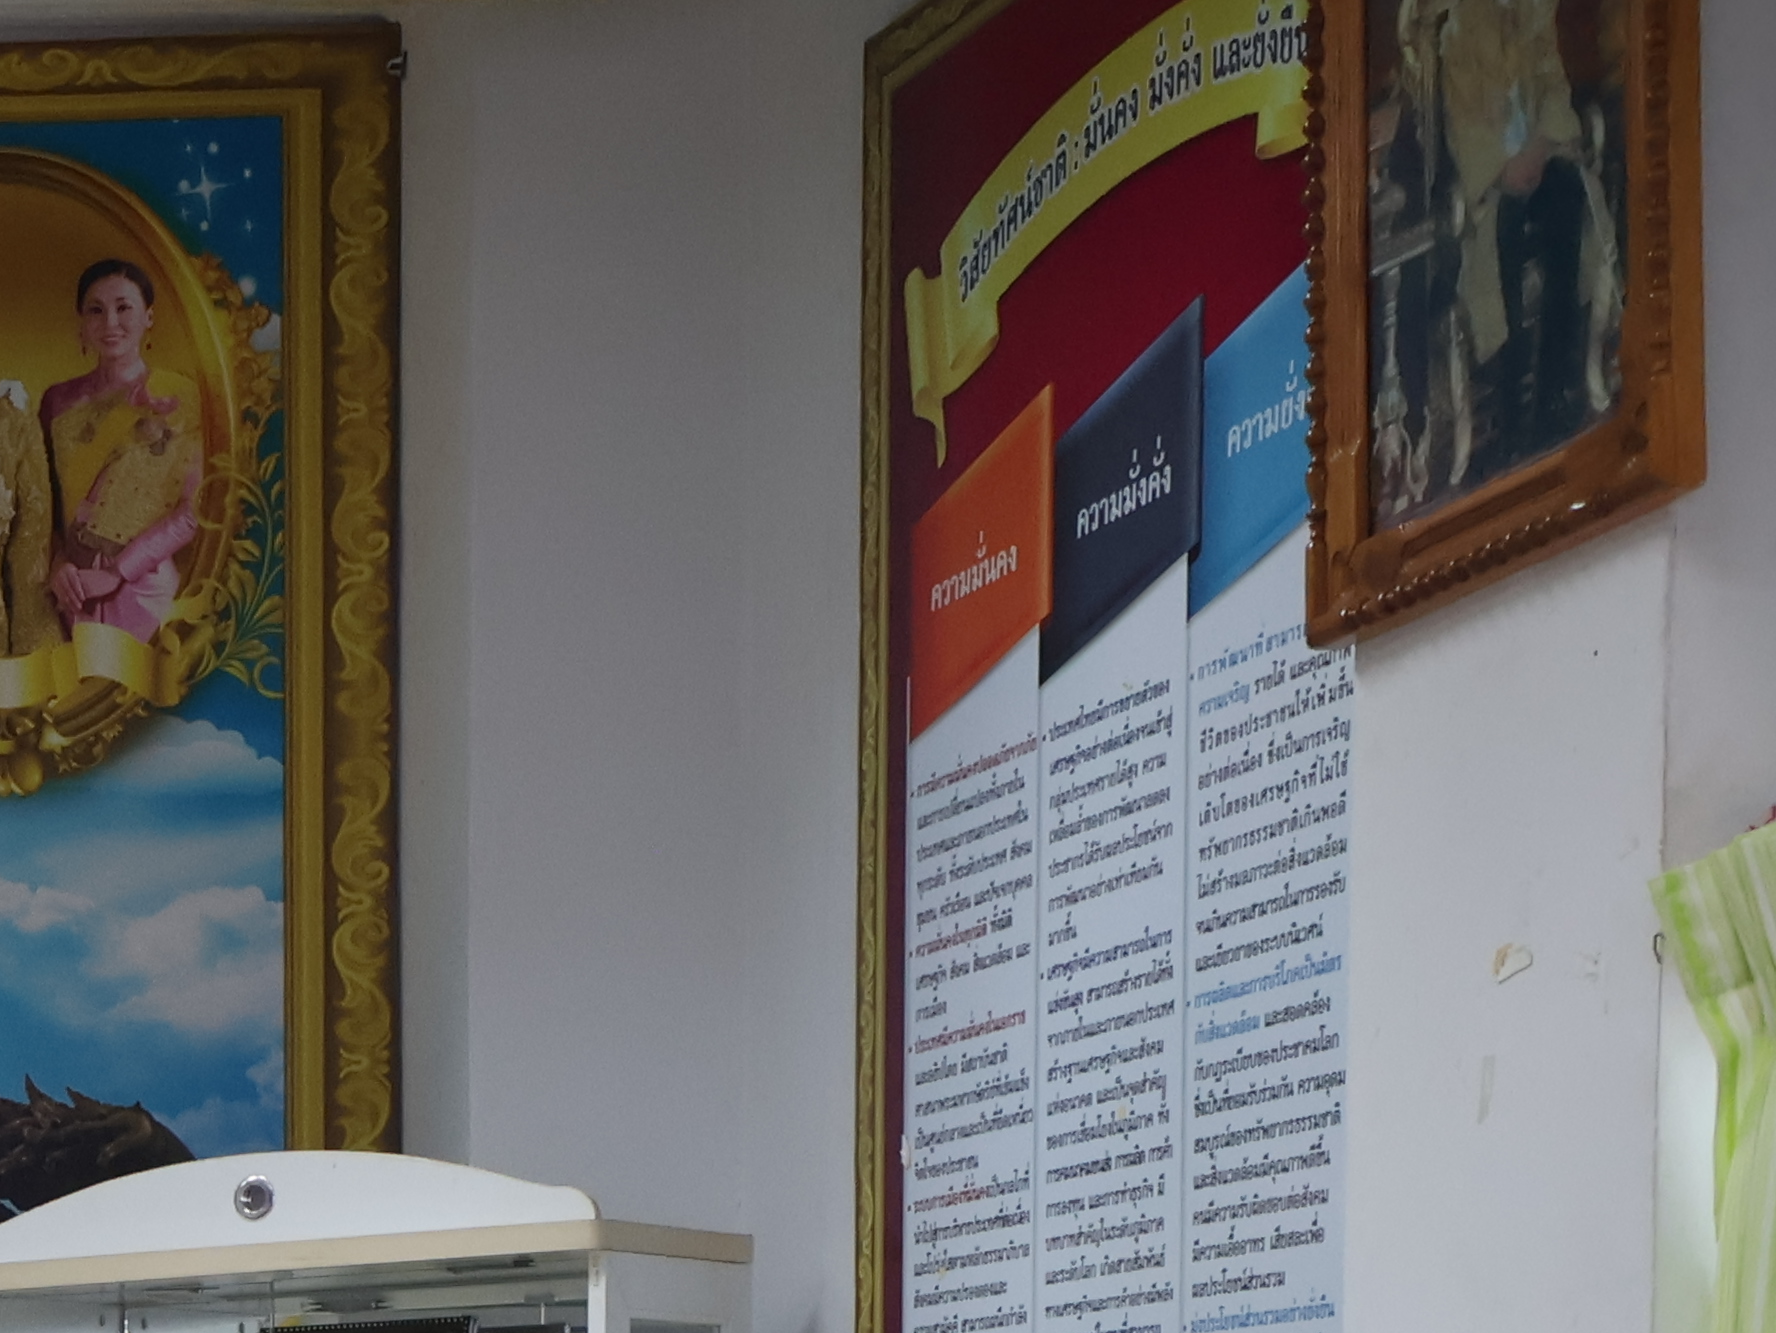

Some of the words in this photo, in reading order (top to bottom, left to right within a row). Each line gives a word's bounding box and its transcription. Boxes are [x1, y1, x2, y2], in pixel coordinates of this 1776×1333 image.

[1083, 78, 1140, 157] มั่นคง
[1148, 17, 1204, 110] มั่งคั่ง
[1227, 359, 1307, 458] ความยั่ง
[1076, 435, 1172, 539] ความมั่งคั่ง
[931, 530, 1017, 611] ความมั่นคง
[1198, 622, 1307, 681] การพัฒนาที่สามาร
